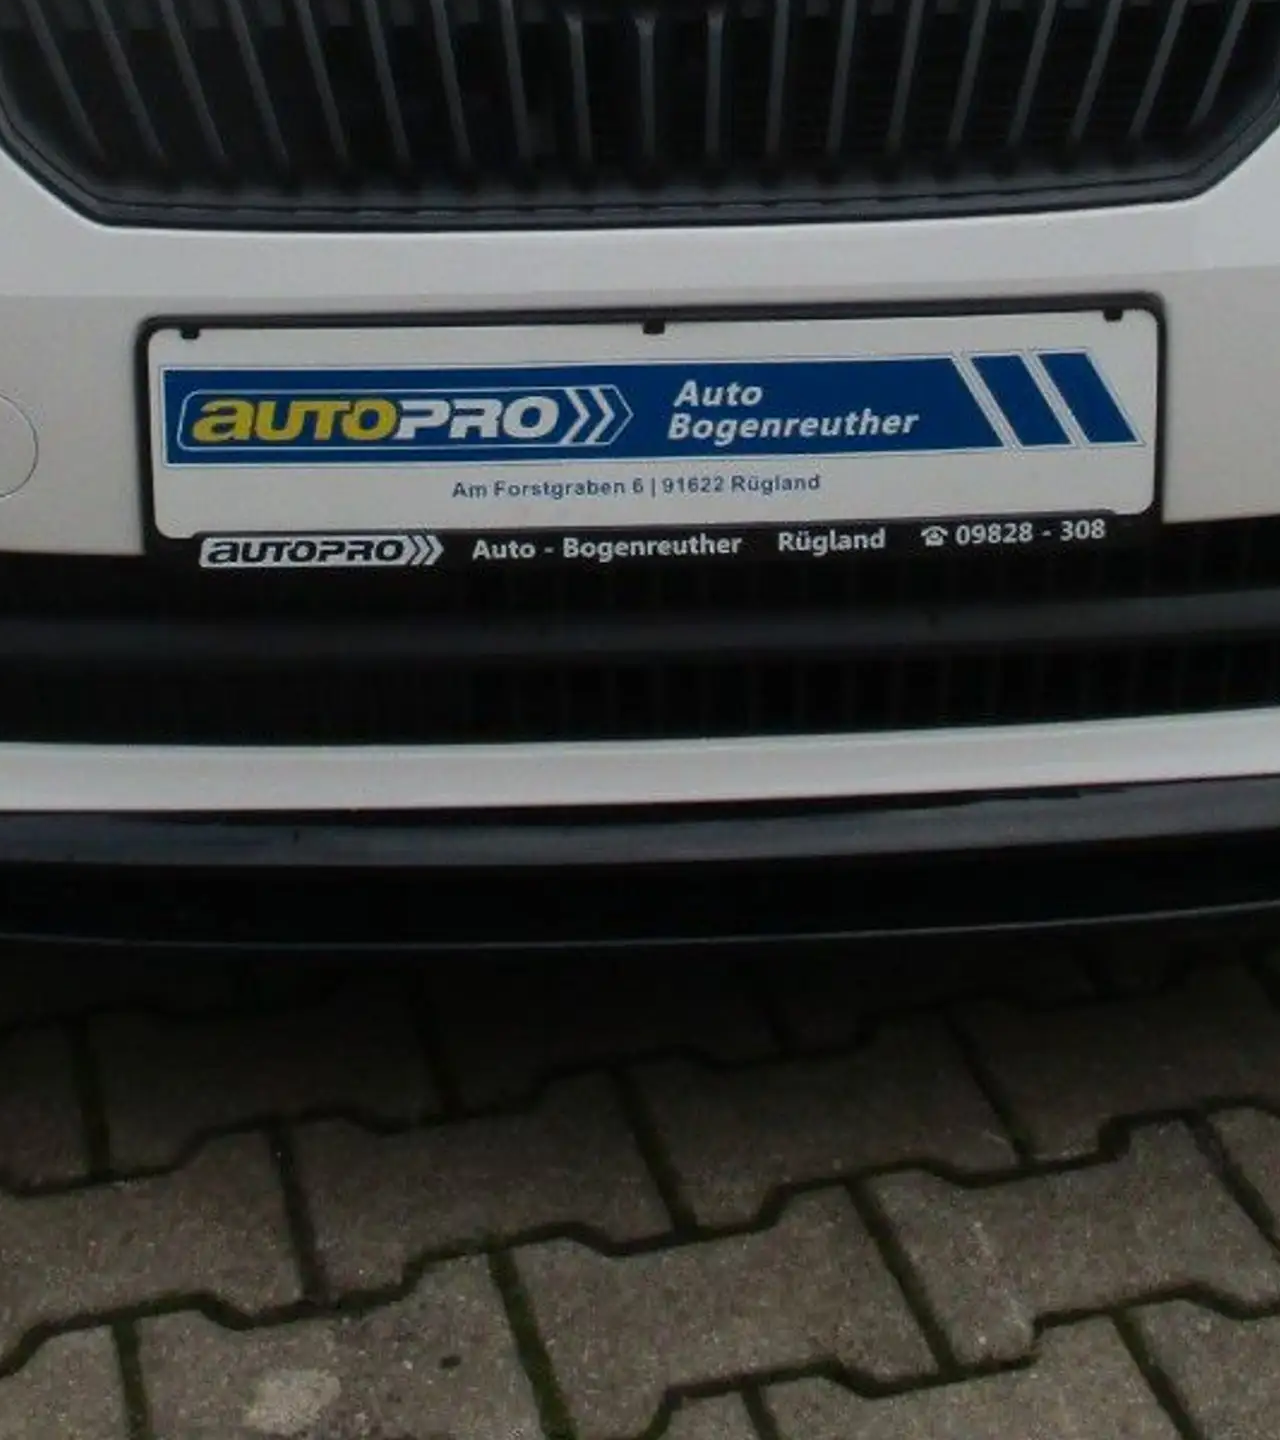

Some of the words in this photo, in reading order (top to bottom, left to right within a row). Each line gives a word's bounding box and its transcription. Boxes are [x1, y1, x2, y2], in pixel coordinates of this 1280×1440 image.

[672, 379, 764, 408] Auto
[667, 408, 920, 447] Bogenreuther
[451, 480, 488, 498] Am
[493, 478, 627, 500] Forstgraben
[632, 477, 645, 495] 6
[661, 475, 724, 495] 91622
[731, 472, 822, 495] Rügland
[471, 538, 537, 561] Auto
[562, 532, 743, 563] Bogenreuther
[777, 526, 887, 557] Rügland
[955, 521, 1034, 547] 09828
[1058, 518, 1108, 542] 308
